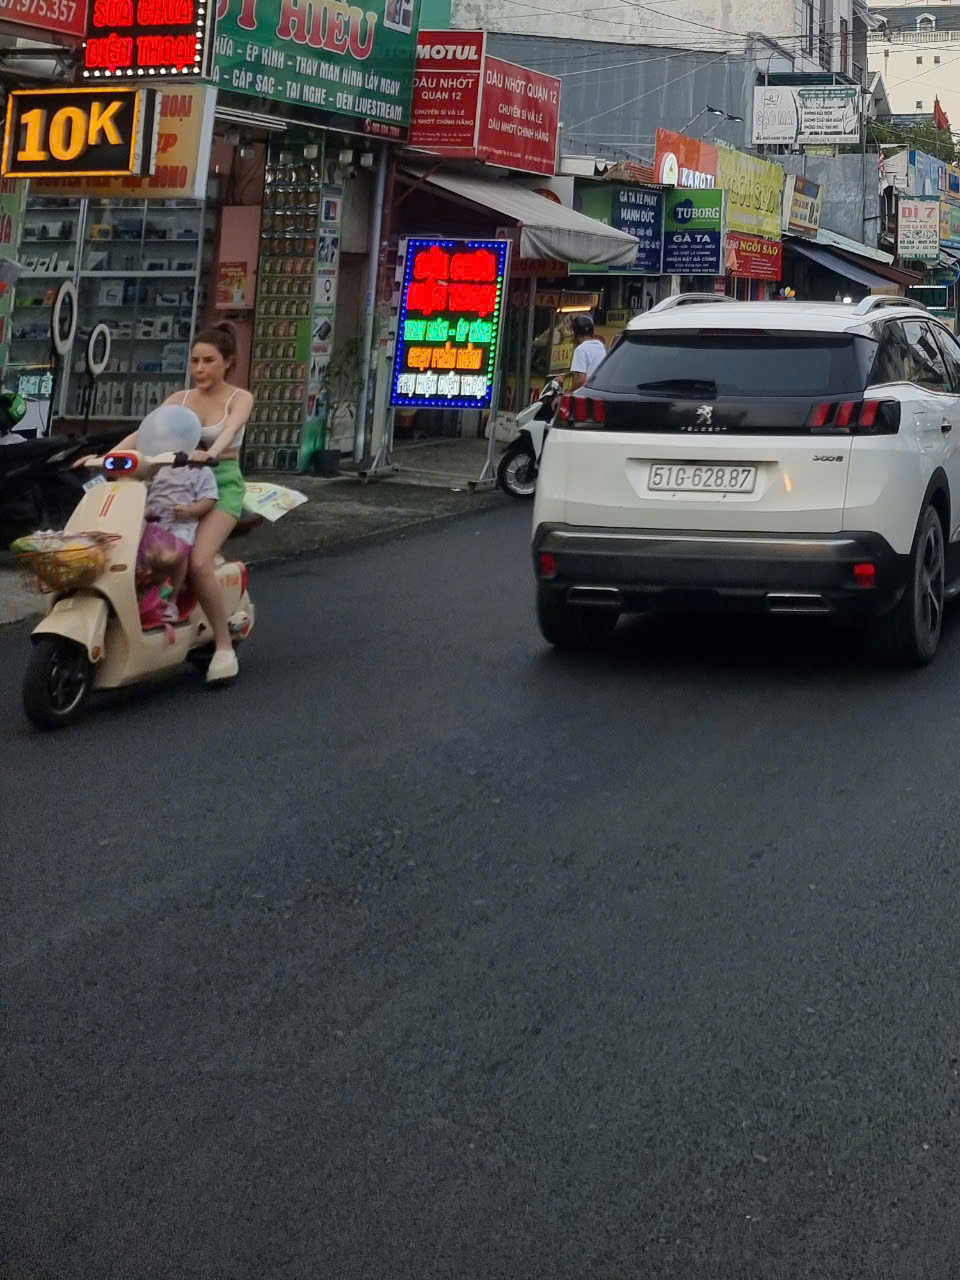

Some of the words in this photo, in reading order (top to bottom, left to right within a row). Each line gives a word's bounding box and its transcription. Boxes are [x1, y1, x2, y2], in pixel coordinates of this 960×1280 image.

[416, 44, 478, 61] MOTUL
[295, 55, 317, 77] THAY
[320, 59, 340, 82] MÀN
[342, 65, 362, 87] HÌNH
[380, 79, 400, 97] NGAY
[440, 76, 475, 89] NHỚT
[421, 91, 449, 102] QUẬN
[452, 91, 462, 100] 12
[527, 83, 548, 103] QUẬN
[549, 90, 557, 105] 12
[302, 85, 326, 105] NGHE
[355, 95, 402, 121] LIVESTREAM
[676, 207, 719, 219] TUBORG
[925, 207, 935, 218] 7
[673, 233, 691, 243] GÀ
[695, 234, 711, 243] TA
[740, 240, 762, 253] NGÔI
[762, 245, 778, 256] SAO
[652, 466, 752, 489] 51G-628.87
